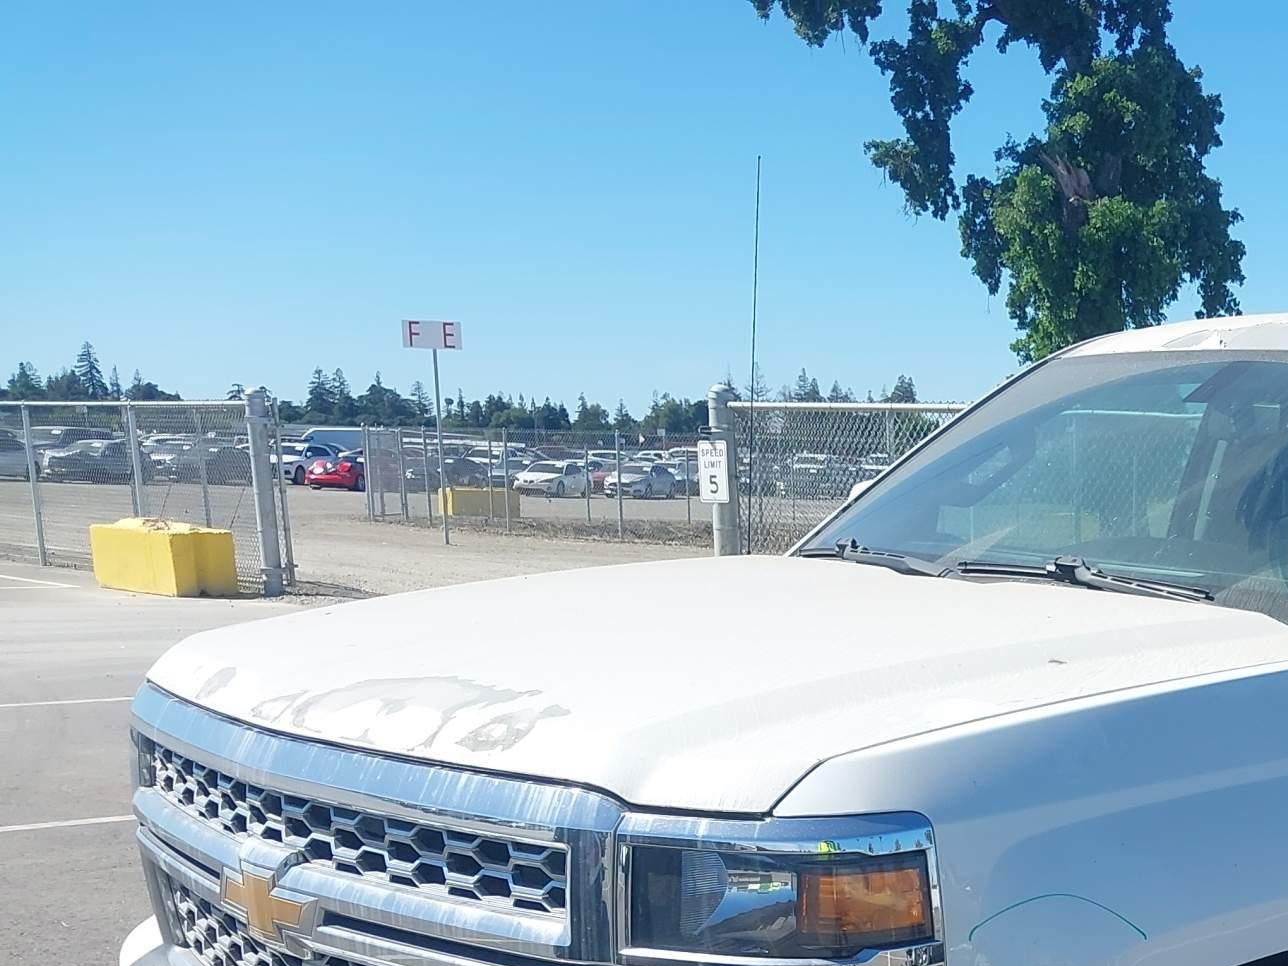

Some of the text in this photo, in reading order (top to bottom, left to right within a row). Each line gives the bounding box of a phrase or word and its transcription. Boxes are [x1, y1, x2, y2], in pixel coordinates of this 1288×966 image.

[408, 321, 456, 349] F E
[701, 448, 724, 457] SPEED
[703, 460, 722, 469] LIMIT
[709, 474, 719, 494] 5
